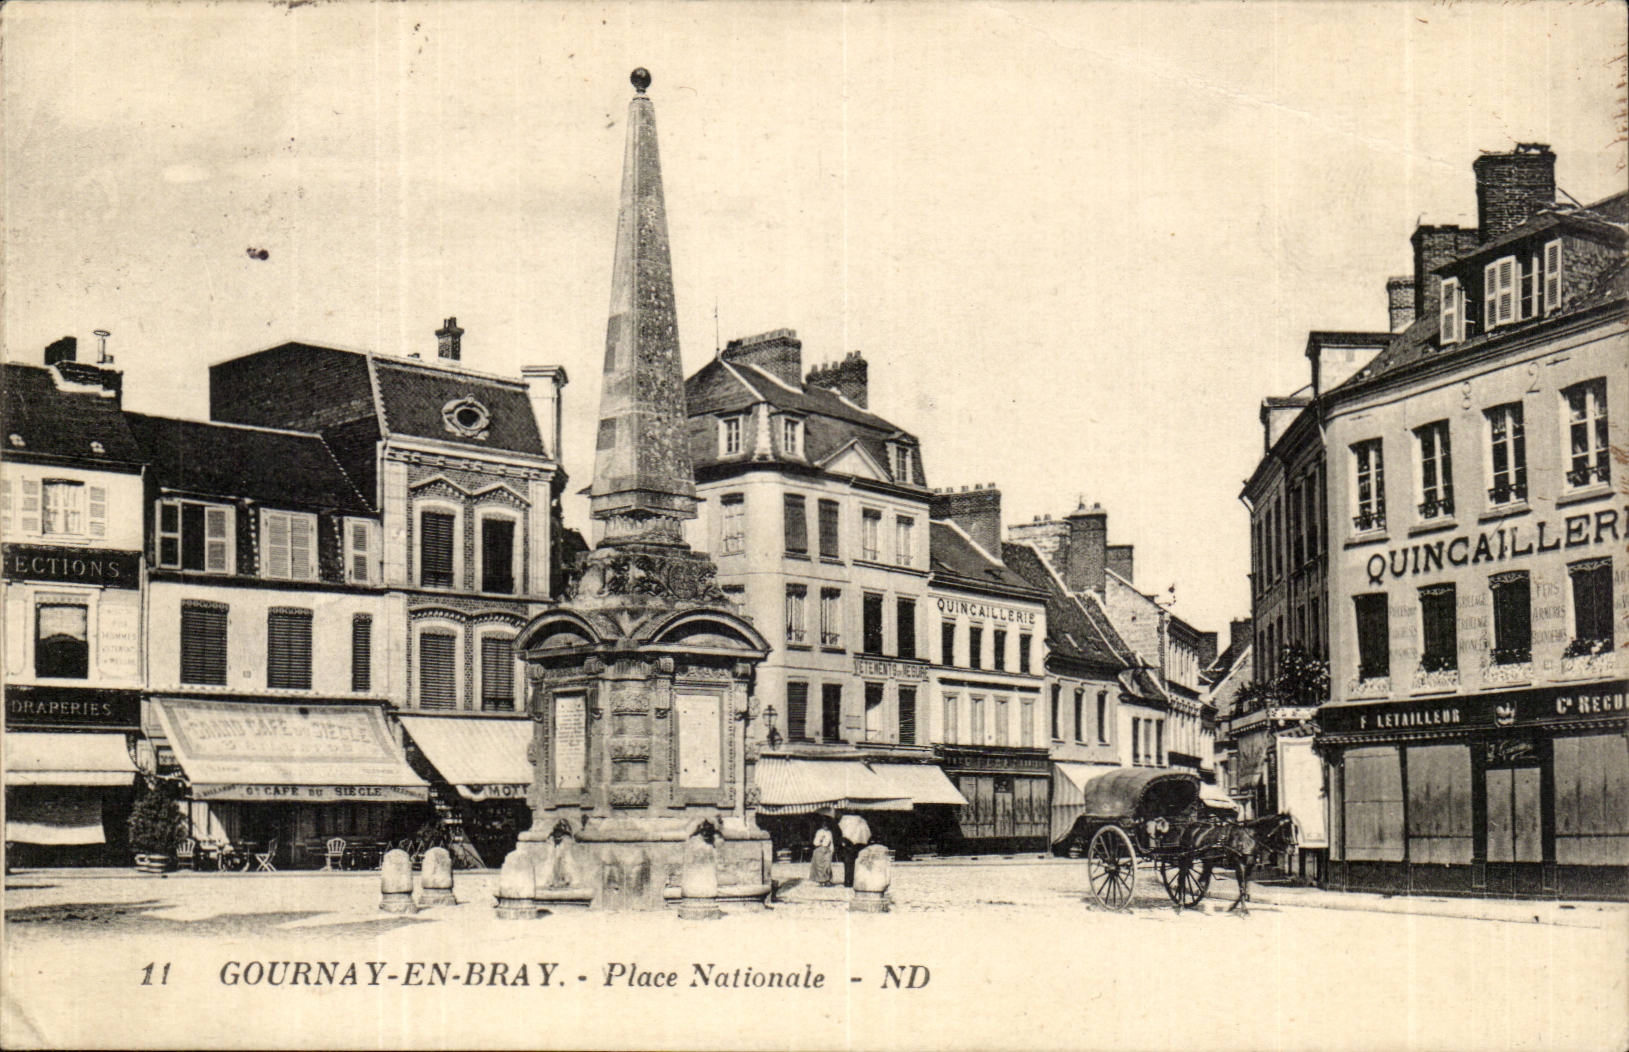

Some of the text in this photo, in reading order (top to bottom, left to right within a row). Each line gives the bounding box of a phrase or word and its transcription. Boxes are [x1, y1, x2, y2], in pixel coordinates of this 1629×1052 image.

[4, 556, 120, 578] ECTIONS
[937, 598, 1036, 624] QUINCAILLERIE
[11, 700, 113, 716] DRAPERIES
[1377, 708, 1460, 728] LETAILLEUR
